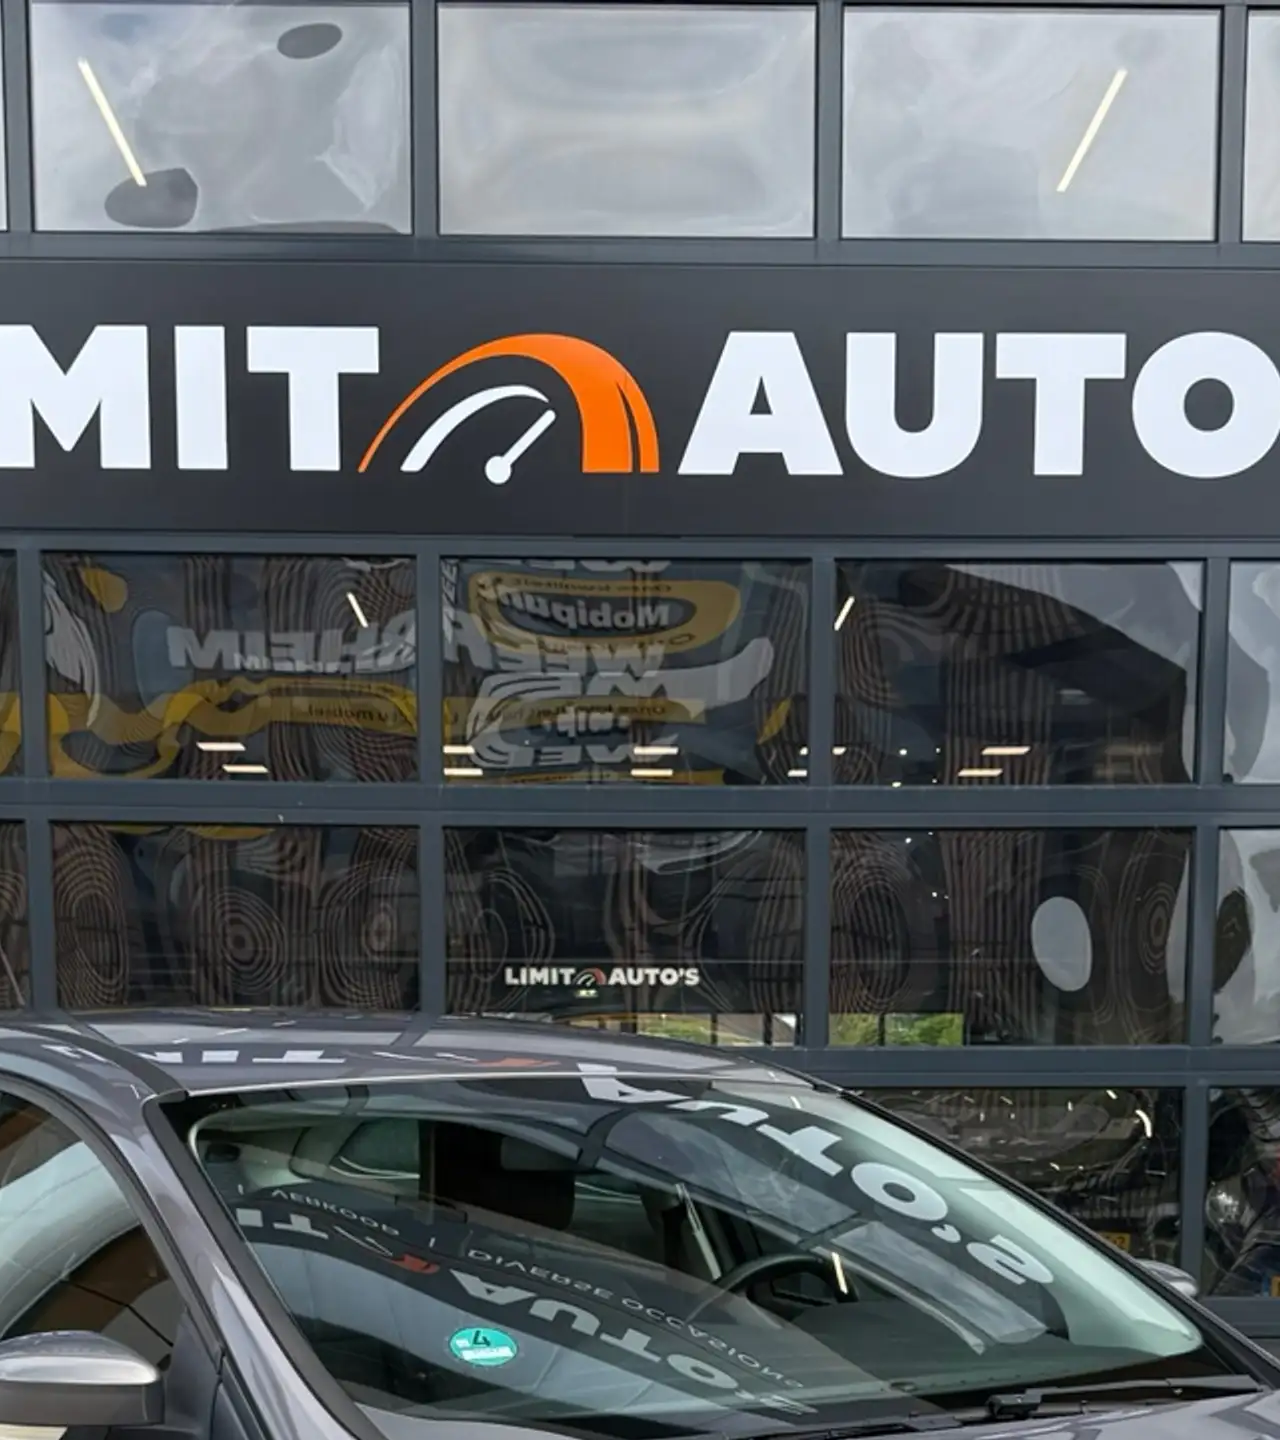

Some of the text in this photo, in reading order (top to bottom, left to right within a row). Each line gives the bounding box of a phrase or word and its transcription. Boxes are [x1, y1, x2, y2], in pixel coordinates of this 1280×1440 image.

[504, 966, 700, 986] LIMIT AUTO'S
[472, 1329, 491, 1347] 4
